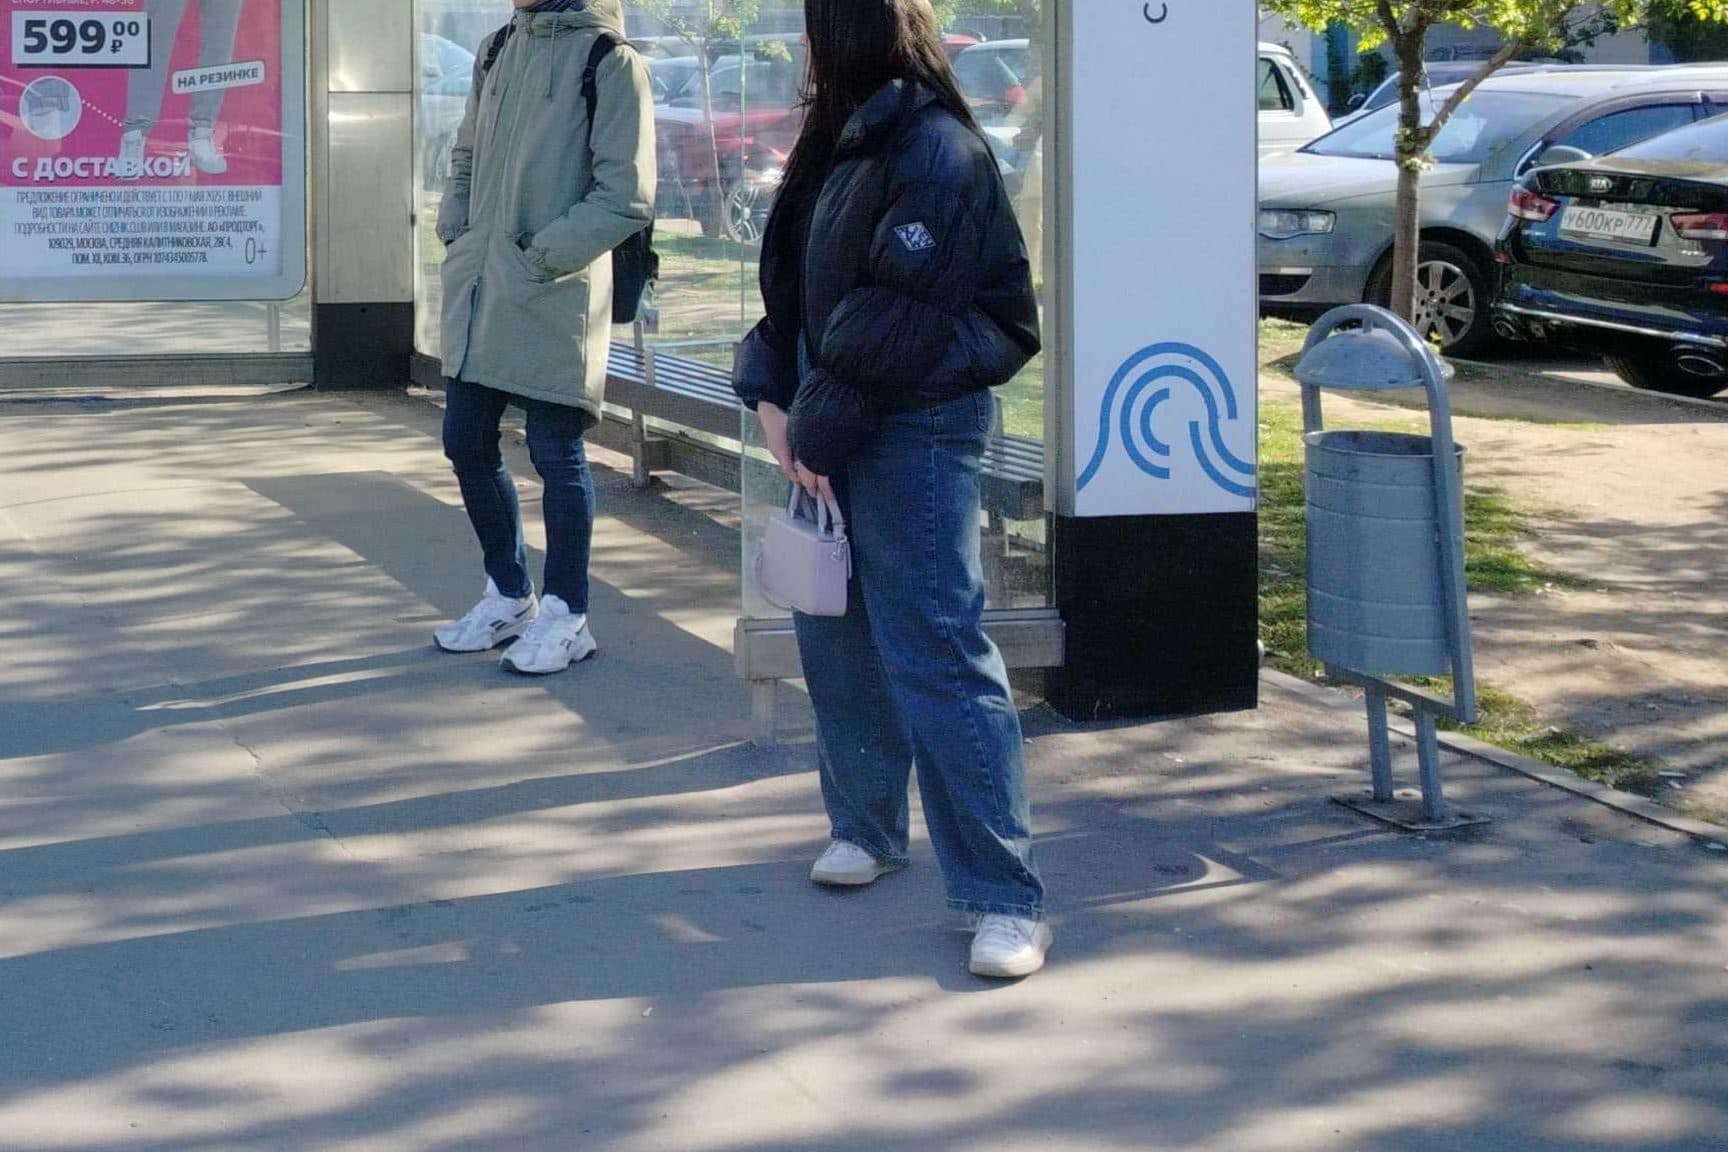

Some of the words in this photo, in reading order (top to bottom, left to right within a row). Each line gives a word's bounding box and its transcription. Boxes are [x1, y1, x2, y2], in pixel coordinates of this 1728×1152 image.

[23, 18, 106, 54] 599
[176, 76, 196, 89] НА
[199, 67, 259, 86] РЕЗИНКЕ
[12, 158, 28, 178] С
[33, 151, 191, 181] ДОСТАВКОЙ
[245, 237, 268, 265] 0+
